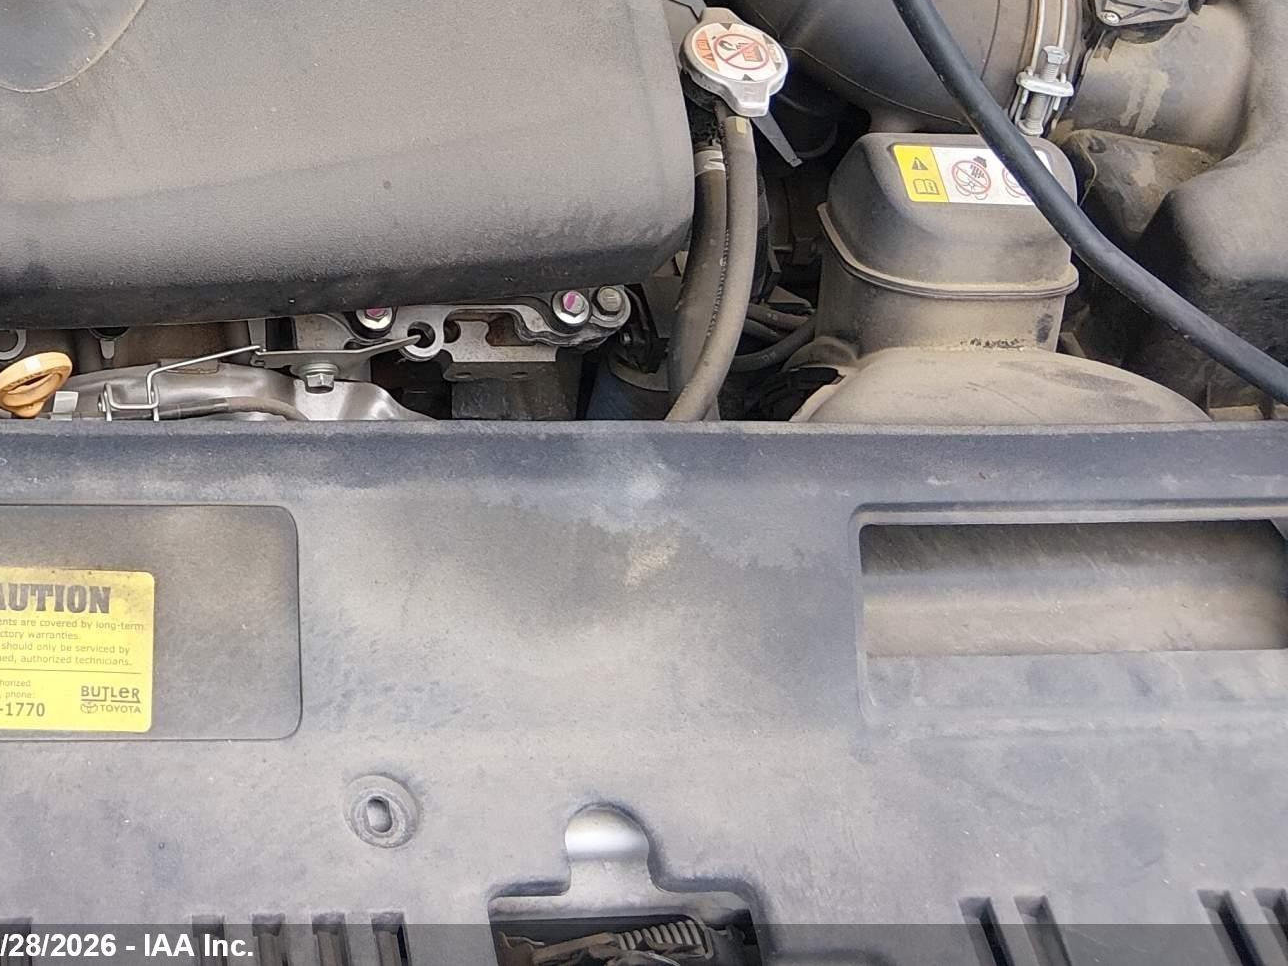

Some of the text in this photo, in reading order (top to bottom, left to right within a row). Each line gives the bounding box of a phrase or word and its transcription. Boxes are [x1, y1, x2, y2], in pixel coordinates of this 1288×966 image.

[20, 619, 37, 627] are
[39, 620, 78, 628] covered
[80, 620, 93, 629] by
[96, 621, 145, 631] long-term
[27, 631, 81, 640] warranties.
[1, 641, 33, 651] should
[36, 642, 57, 652] only
[60, 644, 73, 652] be
[75, 644, 119, 654] serviced
[118, 645, 131, 655] by
[20, 655, 72, 664] authorized
[75, 655, 133, 666] technicians.
[99, 704, 142, 714] TOYOTA
